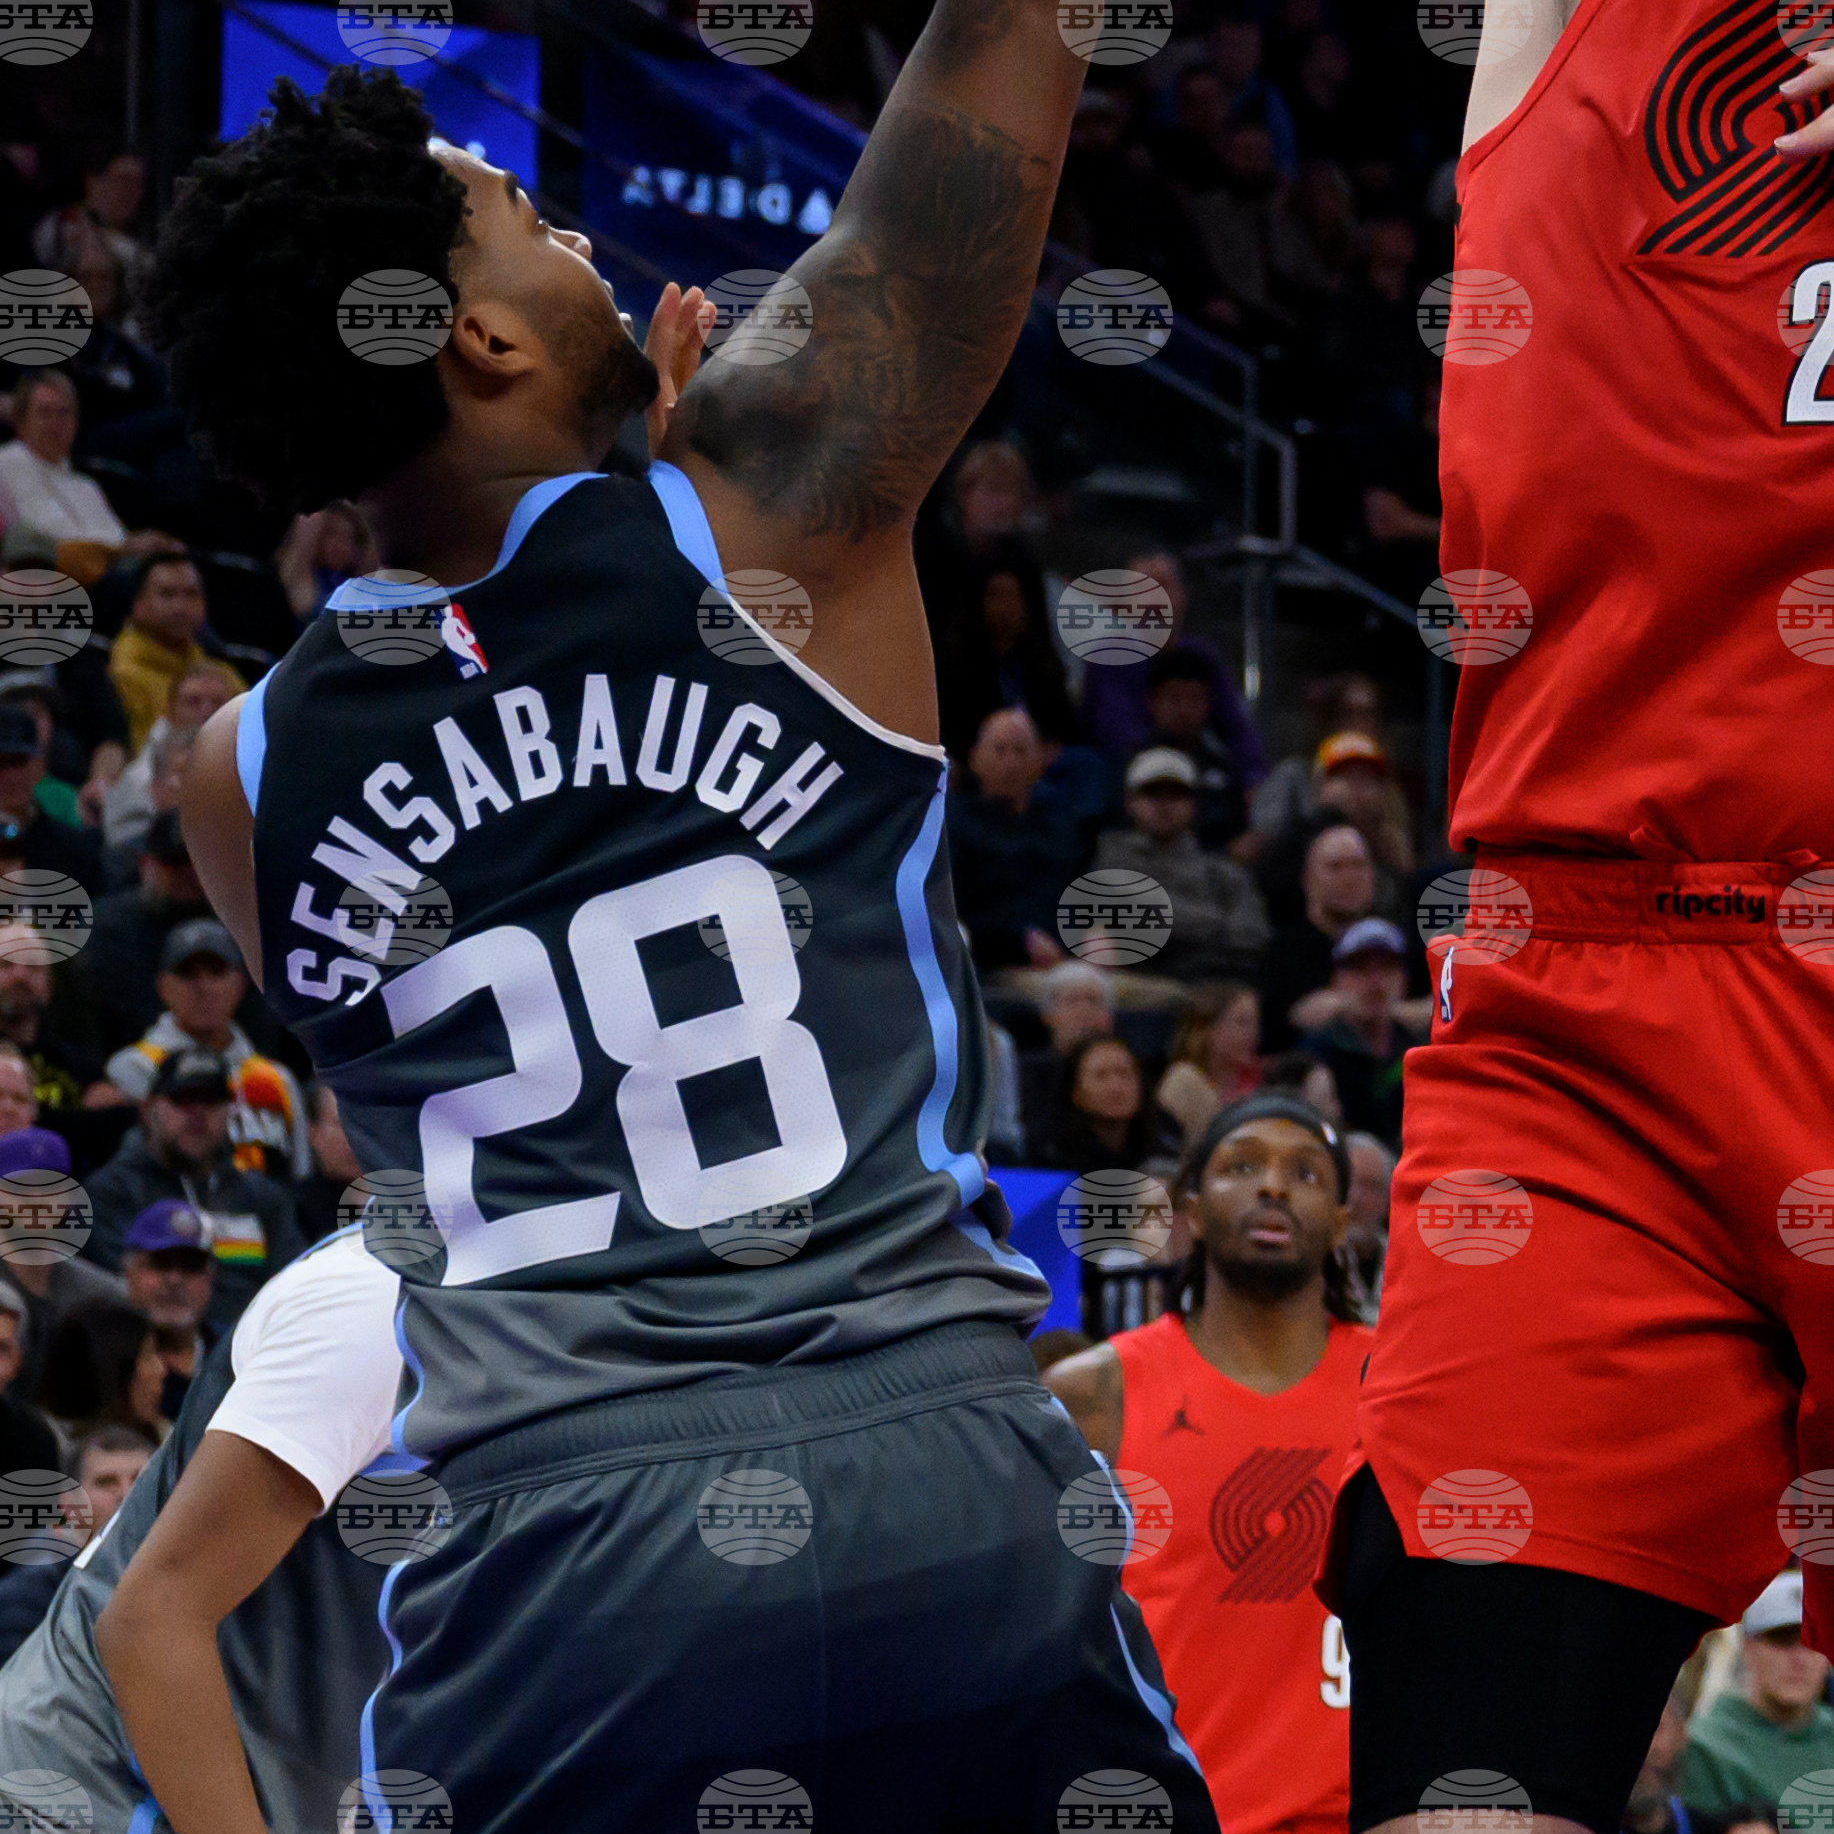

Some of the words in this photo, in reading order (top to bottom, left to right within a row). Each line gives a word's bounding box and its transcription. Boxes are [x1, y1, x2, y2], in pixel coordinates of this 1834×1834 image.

[287, 673, 844, 1007] SENSABAUGH
[1655, 884, 1767, 924] ripcity
[381, 854, 848, 1287] 28
